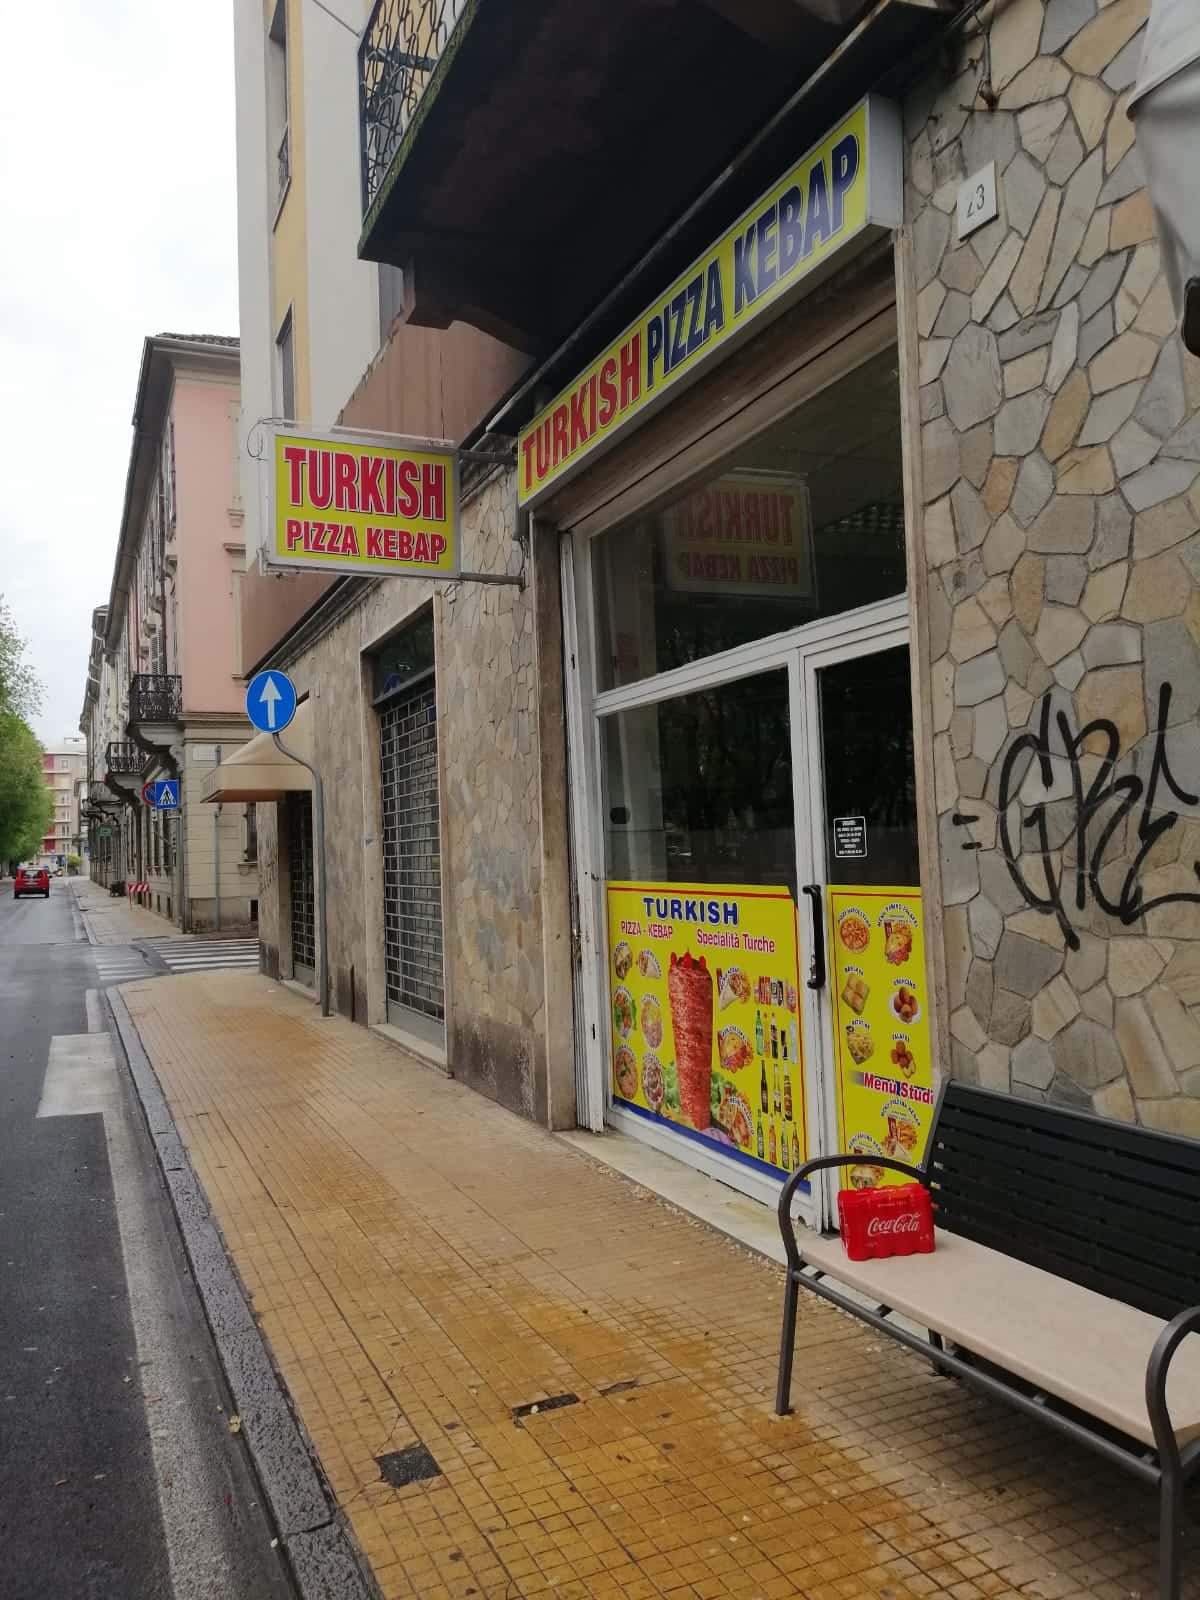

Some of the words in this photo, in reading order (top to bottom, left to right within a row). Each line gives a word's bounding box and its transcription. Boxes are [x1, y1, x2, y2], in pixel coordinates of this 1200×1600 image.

[967, 183, 985, 218] 23
[521, 334, 642, 492] TURKISH
[646, 256, 726, 392] PIZZA
[733, 133, 860, 320] KEBAP
[284, 447, 446, 521] TURKISH
[286, 519, 360, 556] PIZZA
[366, 526, 446, 564] KEBAP
[642, 896, 739, 926] TURKISH
[620, 920, 641, 935] PIZZA
[648, 923, 673, 939] KEBAP
[696, 928, 740, 950] Specialità
[742, 932, 776, 954] Turche
[867, 1212, 921, 1237] Coca-Cola
